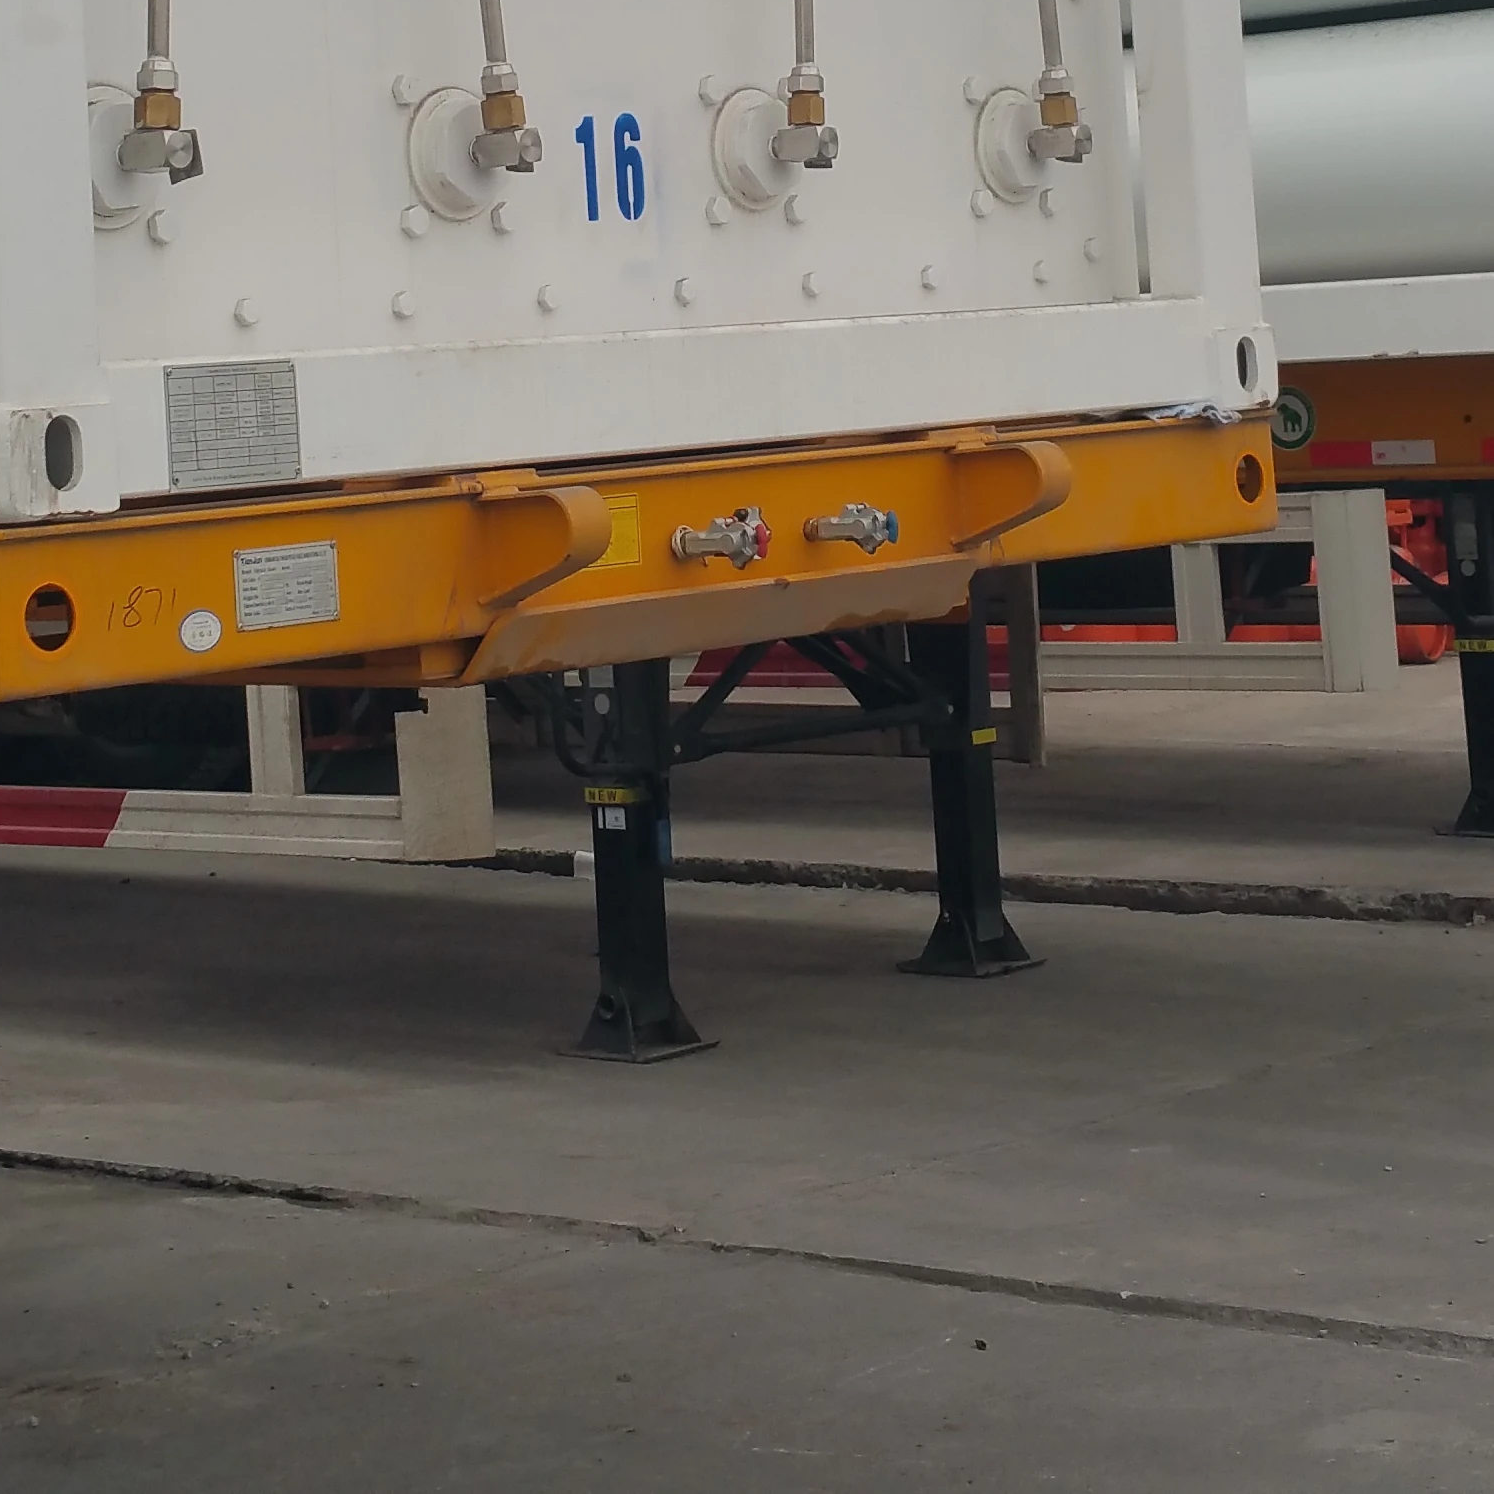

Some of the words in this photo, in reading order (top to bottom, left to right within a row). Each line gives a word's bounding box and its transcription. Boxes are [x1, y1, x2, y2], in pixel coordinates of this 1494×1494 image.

[575, 112, 645, 222] 16
[108, 585, 177, 629] 1871
[588, 789, 617, 802] NEW
